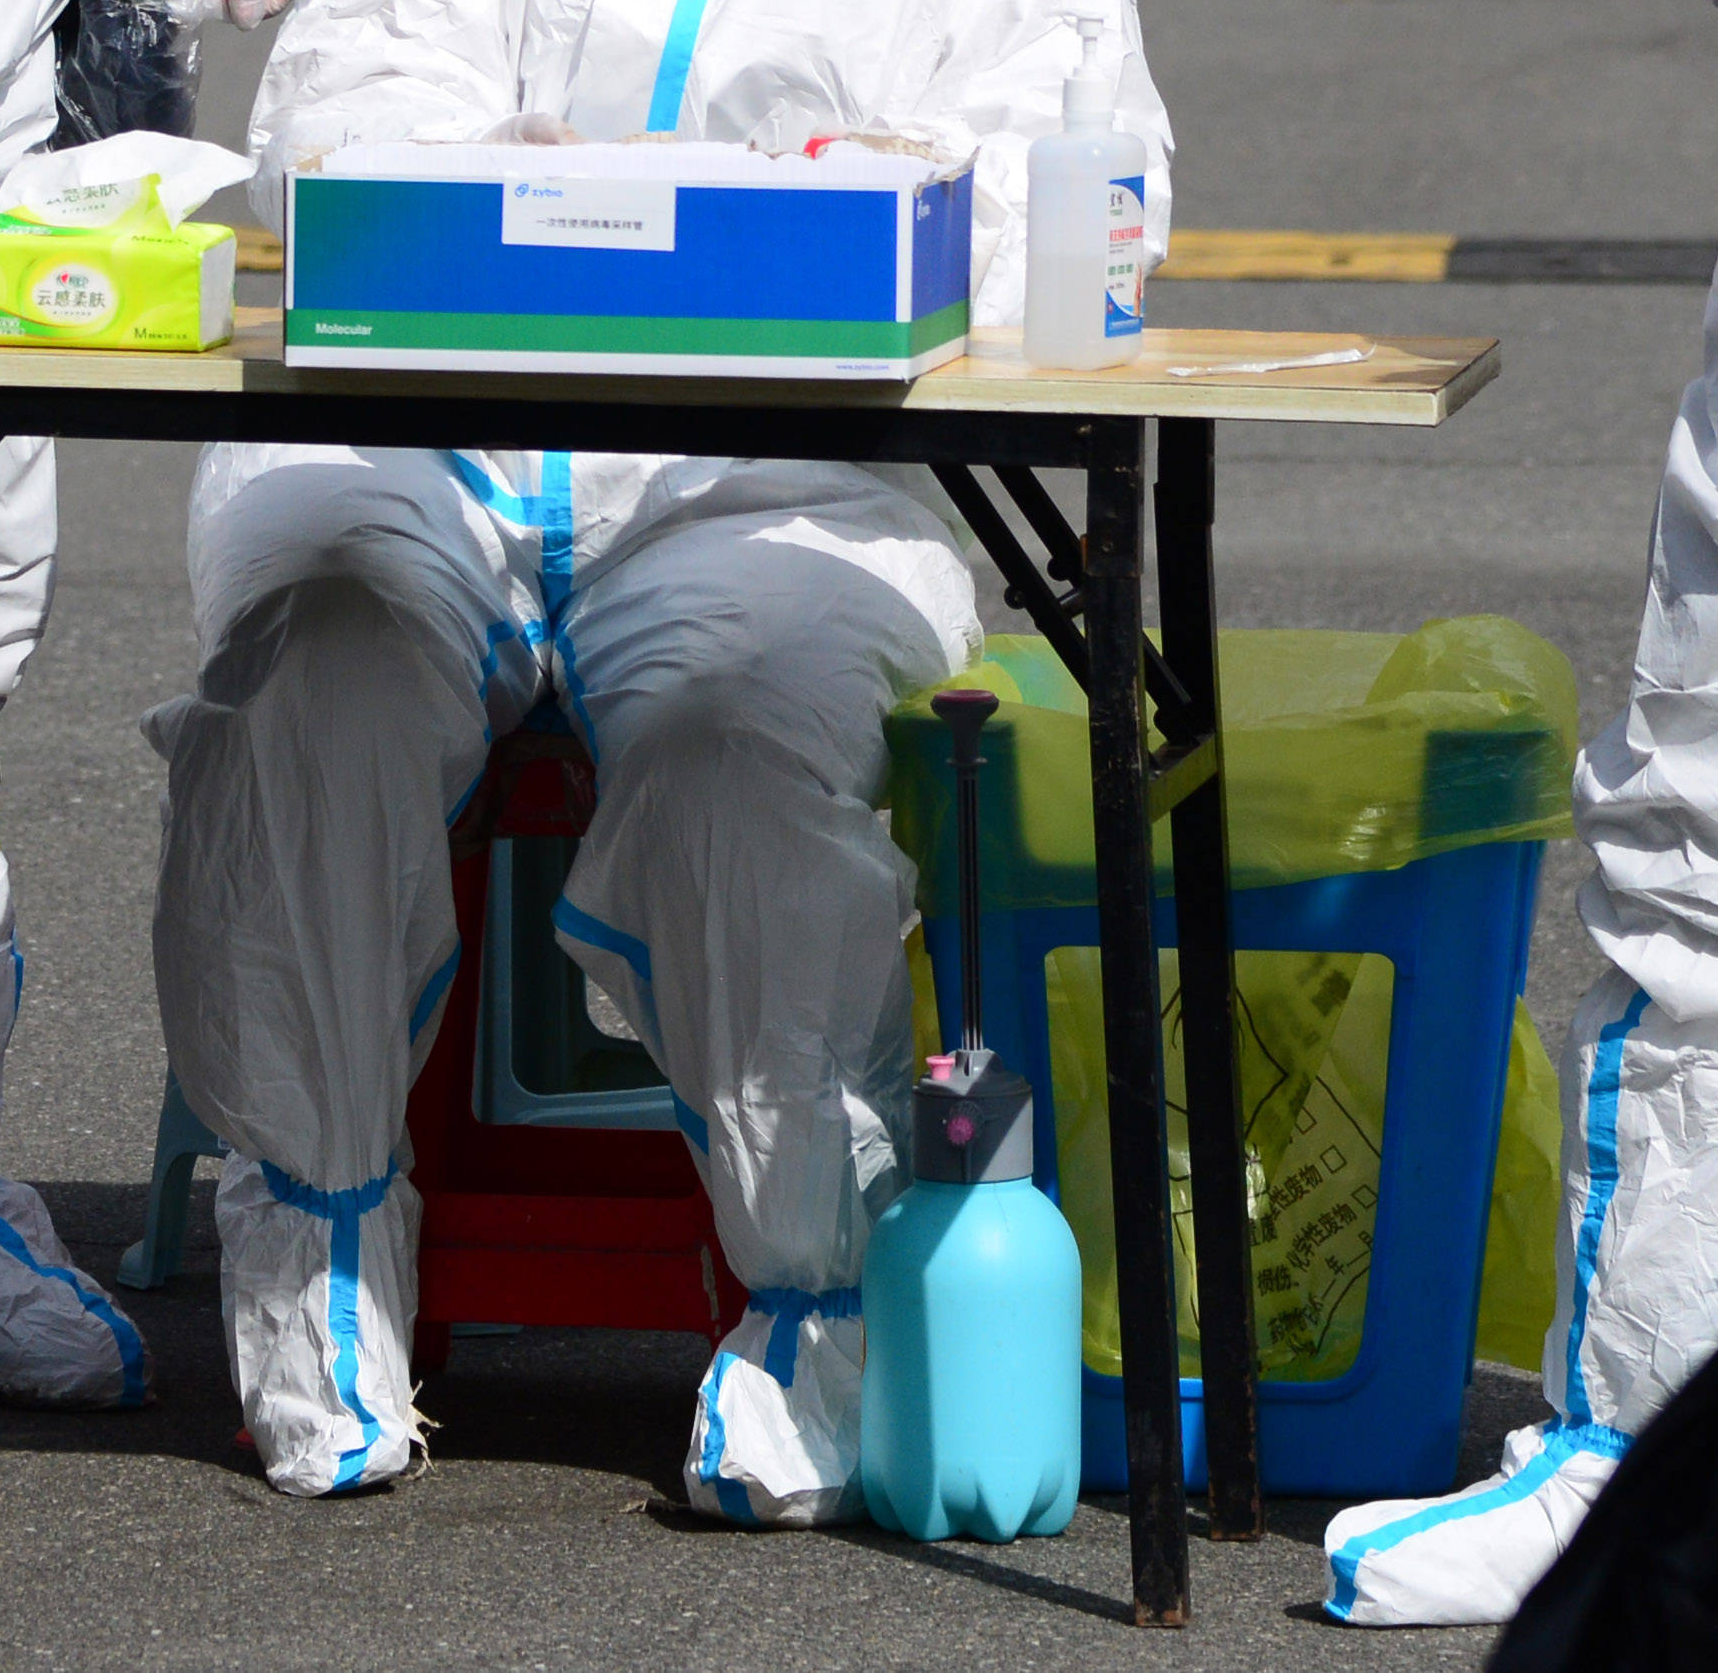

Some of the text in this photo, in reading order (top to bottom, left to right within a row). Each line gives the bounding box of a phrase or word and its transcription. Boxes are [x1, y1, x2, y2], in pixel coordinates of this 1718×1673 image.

[532, 187, 564, 198] zybio
[536, 217, 643, 231] 一次性使用病毒采样管
[37, 290, 106, 308] 云感柔肤
[315, 322, 373, 336] Molecular
[1286, 1203, 1357, 1273] 化学性废物
